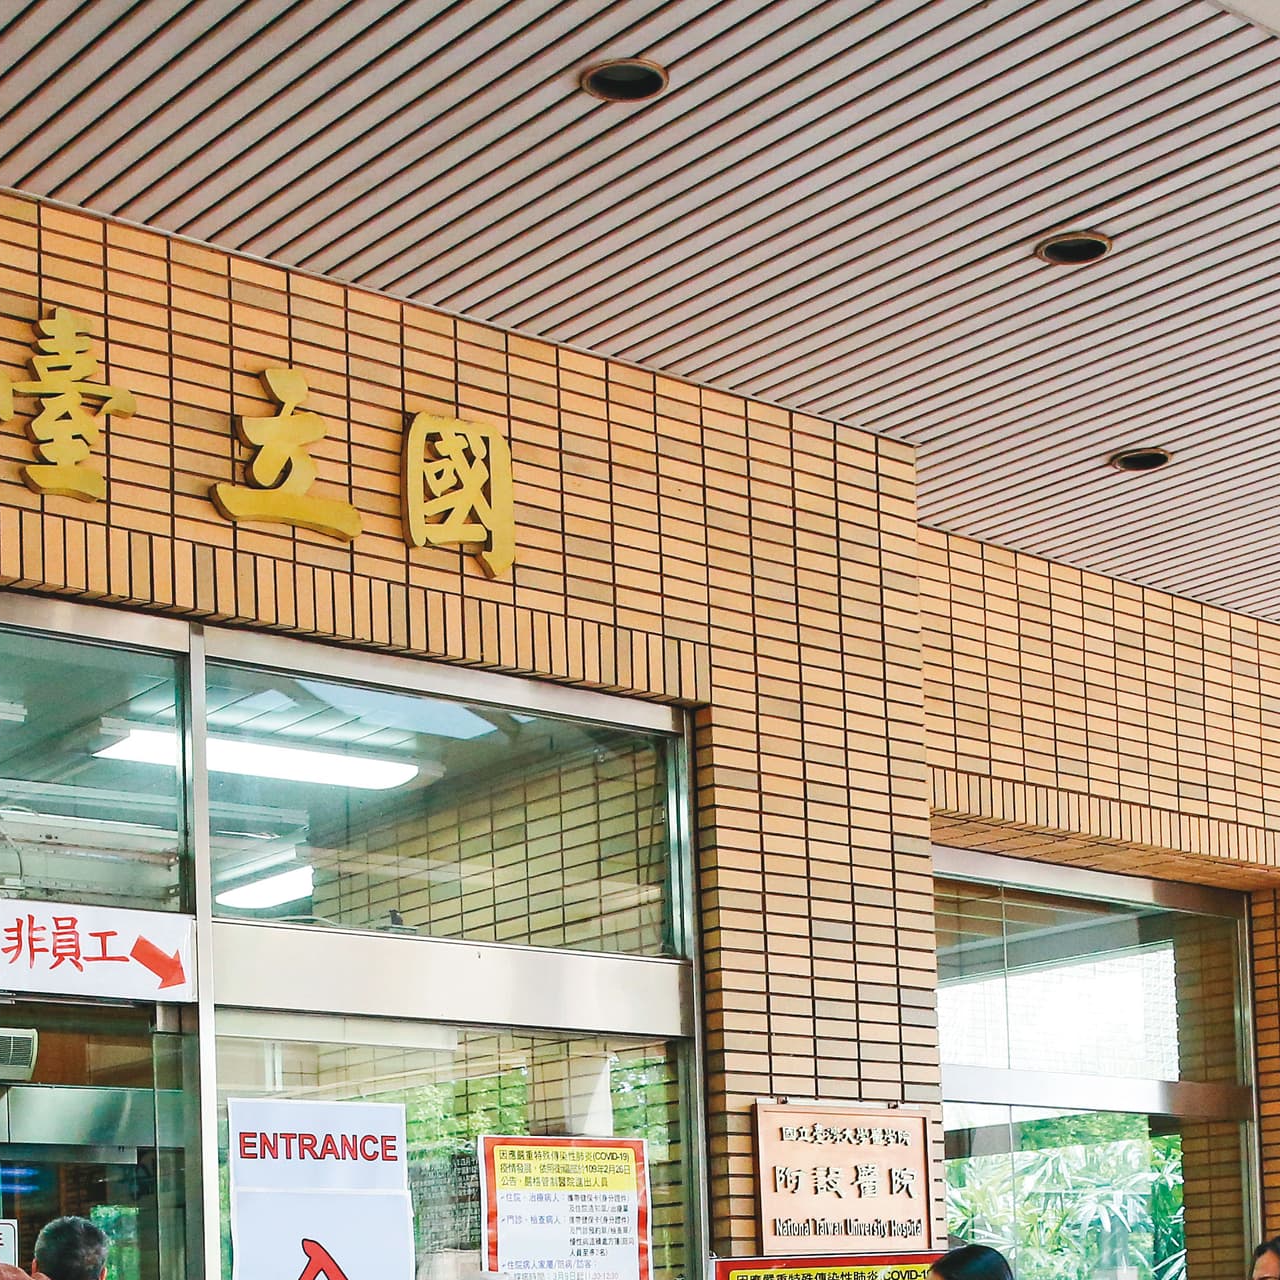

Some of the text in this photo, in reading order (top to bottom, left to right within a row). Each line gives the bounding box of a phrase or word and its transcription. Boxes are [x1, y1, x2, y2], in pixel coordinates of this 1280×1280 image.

[1, 914, 130, 972] 非員工
[238, 1131, 398, 1162] ENTRANCE
[774, 1218, 811, 1237] National
[812, 1218, 844, 1237] Taiwan
[845, 1218, 889, 1238] University
